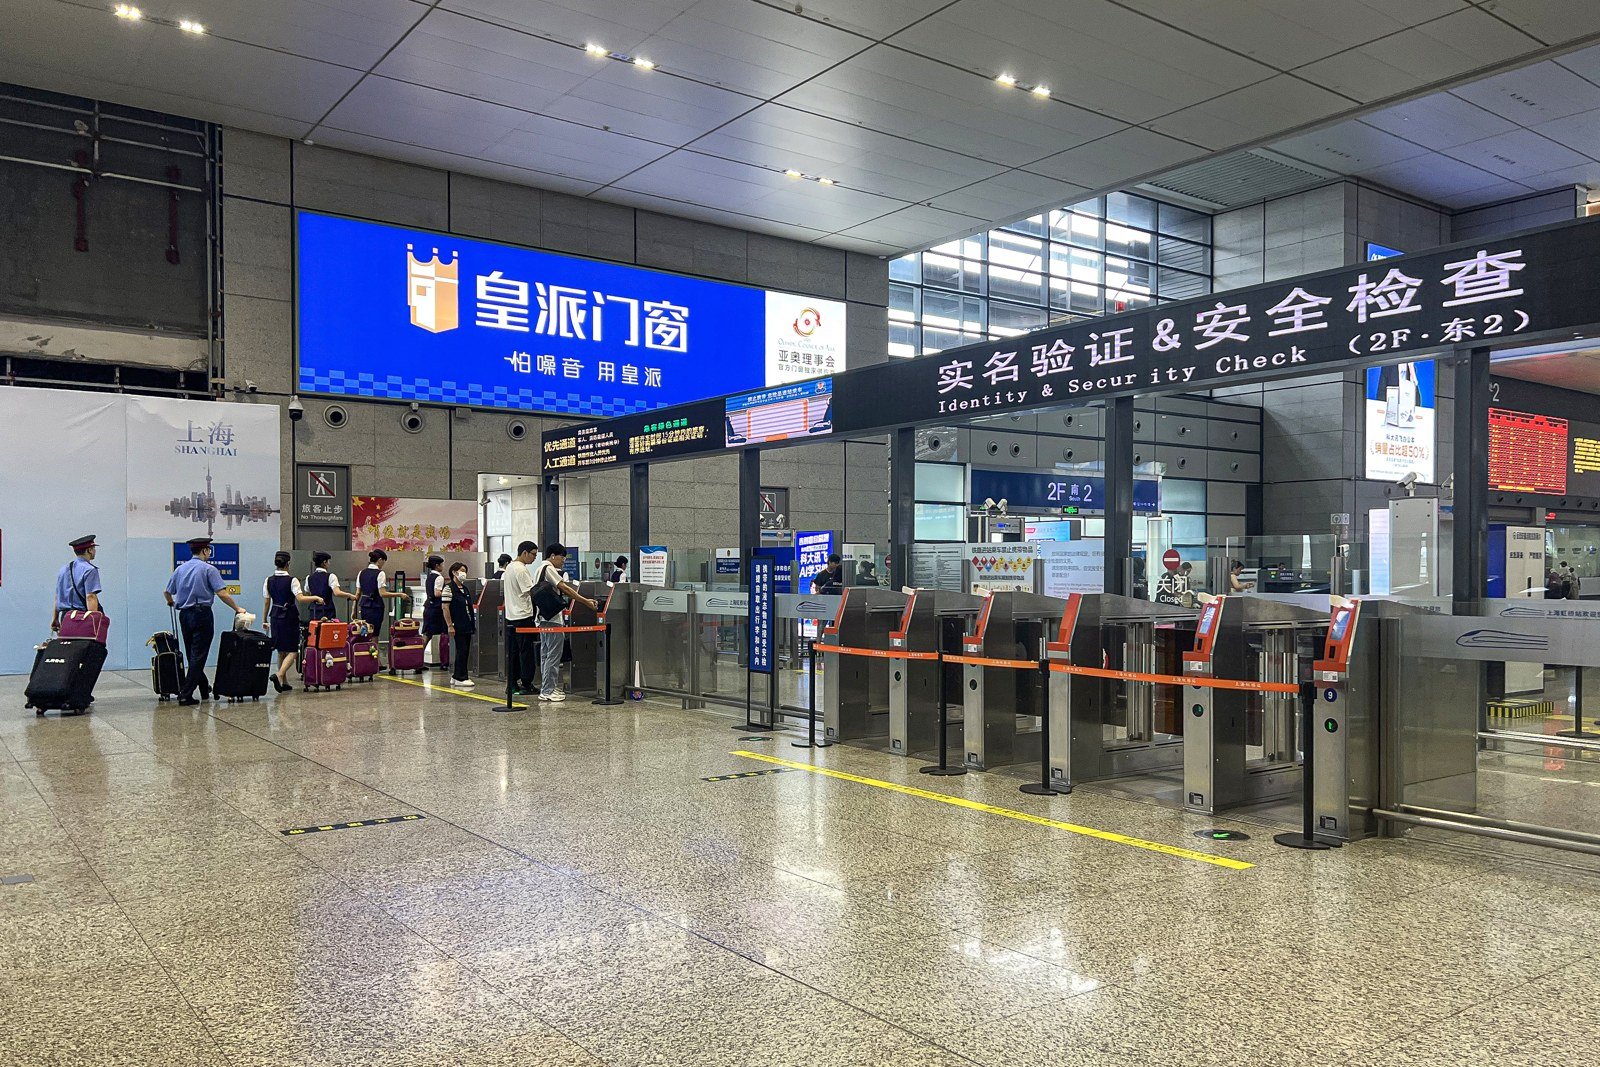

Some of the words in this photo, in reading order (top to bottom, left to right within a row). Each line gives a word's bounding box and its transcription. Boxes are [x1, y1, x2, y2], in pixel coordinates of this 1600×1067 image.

[475, 270, 689, 353] 皇派门窗
[778, 350, 835, 368] 亚奥理事会
[504, 351, 585, 380] 怕噪音
[598, 360, 662, 388] 用皇派
[938, 390, 1028, 413] Identity
[1041, 383, 1054, 397] &
[1215, 345, 1307, 374] Check
[177, 419, 235, 446] 上海
[174, 445, 238, 457] SHANGHAI
[543, 437, 576, 453] 优先通道
[1375, 442, 1425, 459] 销量占比超50%
[543, 454, 576, 469] 人工通道
[1047, 482, 1067, 501] 2F
[1070, 483, 1080, 496] 南
[1083, 484, 1092, 502] 2
[301, 504, 344, 515] 旅客止步
[1156, 574, 1188, 594] 关闭
[1159, 595, 1183, 603] Closed
